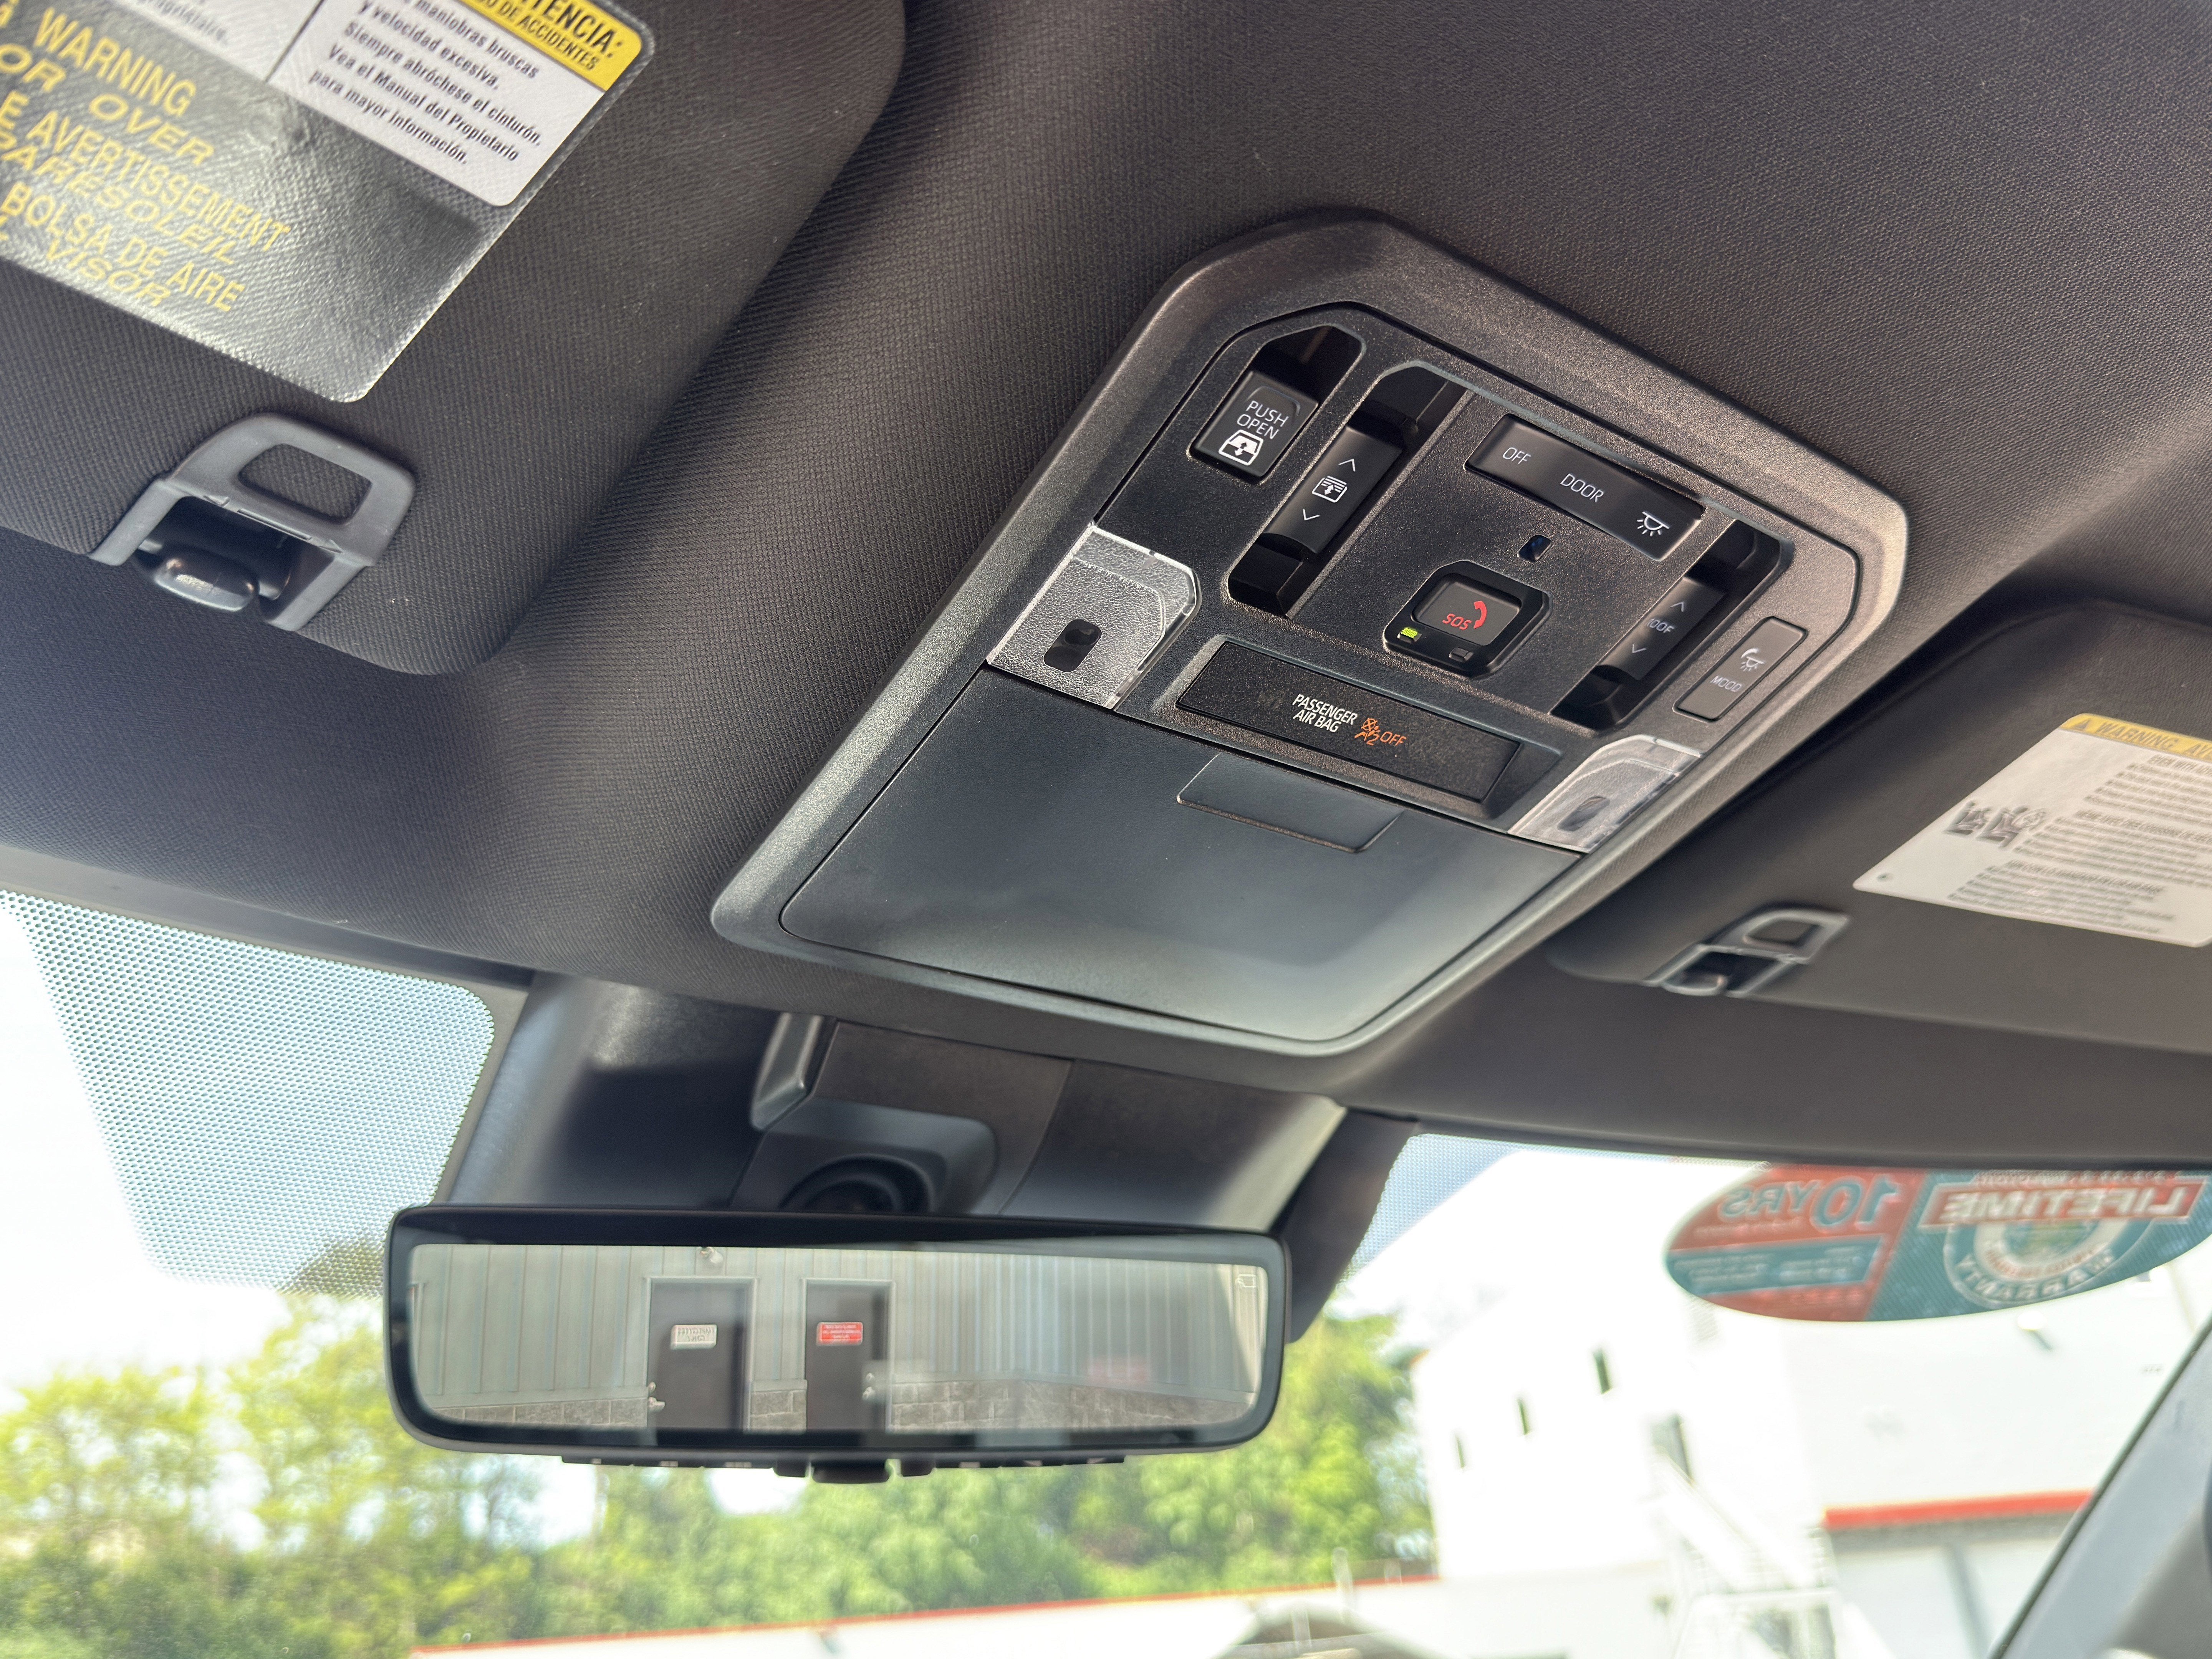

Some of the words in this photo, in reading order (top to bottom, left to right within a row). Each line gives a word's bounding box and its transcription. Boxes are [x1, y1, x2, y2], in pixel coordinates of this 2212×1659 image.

[34, 7, 196, 117] WARNING
[372, 5, 442, 53] velocidad
[440, 44, 499, 90] excesiva.
[415, 0, 487, 47] maniobras
[488, 38, 539, 79] bruscas
[517, 15, 600, 71] ACCIDENTES
[329, 44, 356, 70] Vea
[358, 63, 371, 78] el
[375, 68, 423, 108] Manual
[426, 99, 447, 121] del
[449, 113, 520, 162] Propietario
[345, 22, 403, 66] Siempre
[404, 55, 471, 104] abróchese
[473, 98, 487, 113] el
[488, 106, 541, 146] cinturón.
[89, 94, 214, 166] OVER
[309, 70, 342, 94] para
[345, 88, 389, 120] mayor
[389, 110, 468, 164] información.
[26, 111, 291, 252] AVERTISSEMENT
[1, 182, 112, 254] BOLSA
[118, 236, 168, 278] DE
[165, 261, 245, 312] AIRE
[46, 238, 171, 307] VISOR
[1236, 414, 1279, 440] OPEN
[1245, 400, 1289, 428] PUSH
[1502, 447, 1531, 465] OFF
[1560, 473, 1604, 503] DOOR
[1442, 613, 1472, 630] SOS
[1292, 694, 1358, 725] PASSENGER
[1710, 675, 1743, 692] MOOD
[1292, 709, 1316, 725] AIR
[1314, 717, 1341, 733] BAG
[1380, 731, 1407, 746] OFF
[2095, 722, 2179, 749] WARNING
